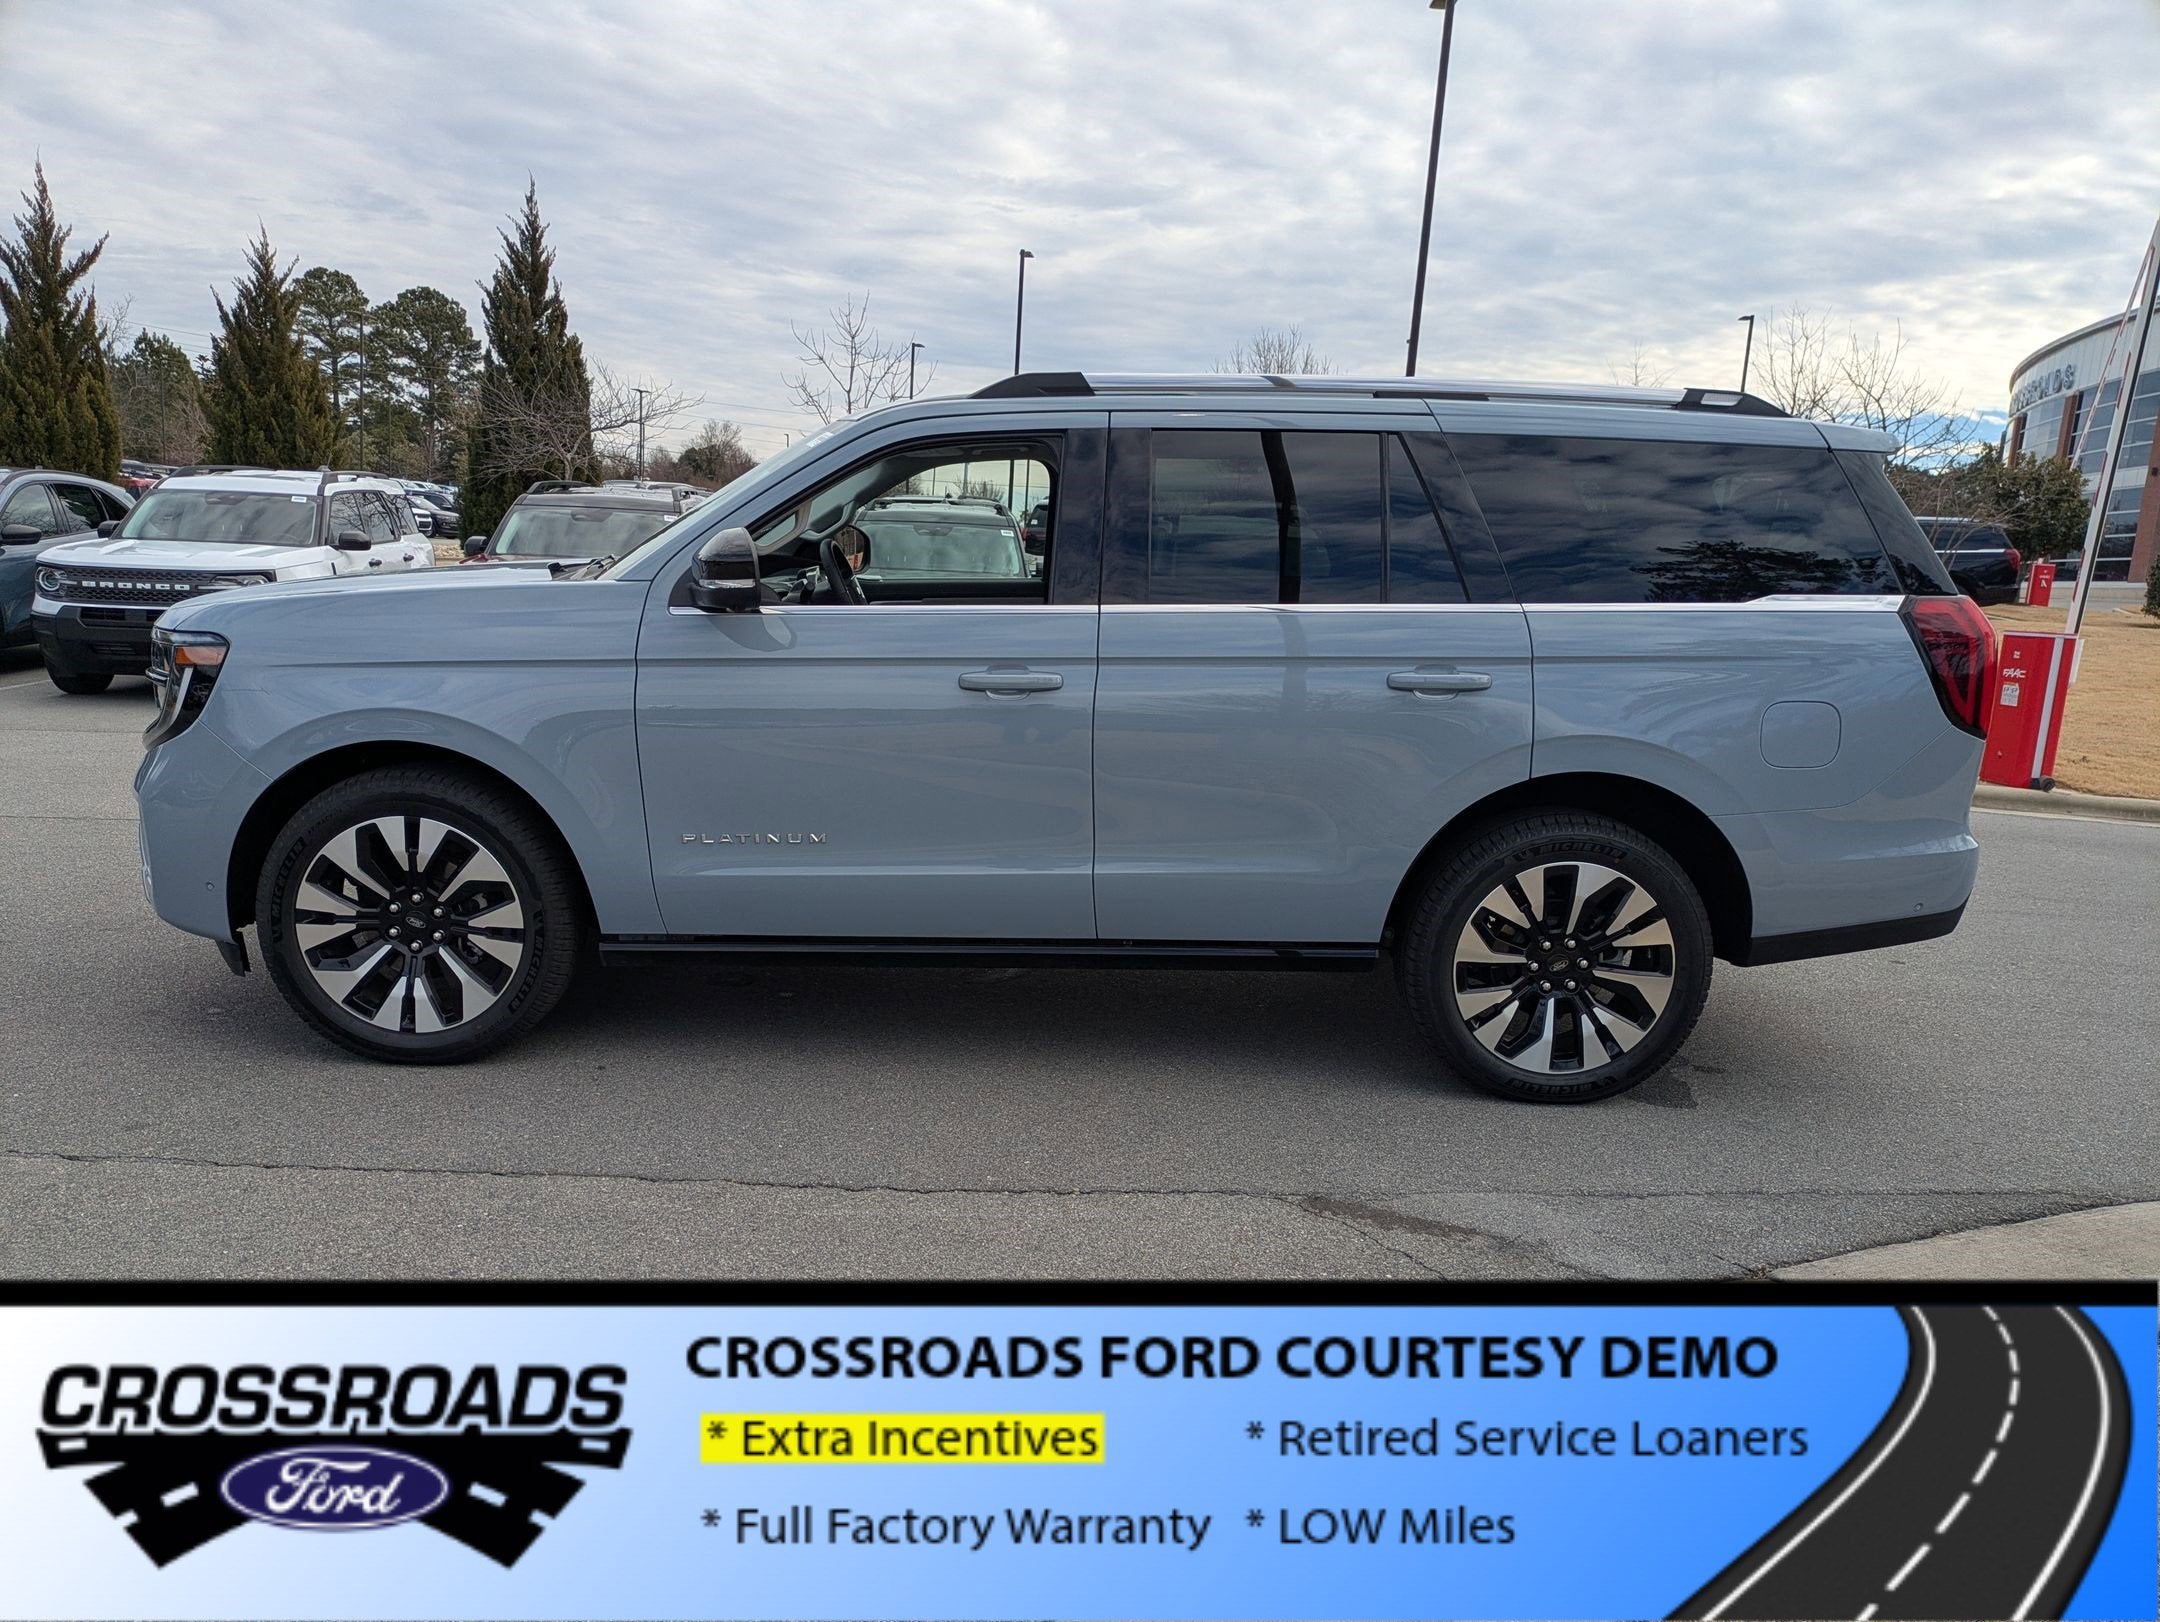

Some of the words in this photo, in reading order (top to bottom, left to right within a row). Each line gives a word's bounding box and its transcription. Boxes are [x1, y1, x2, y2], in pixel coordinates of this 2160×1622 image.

[82, 581, 190, 590] BRONCO
[682, 833, 826, 844] PLATINUM
[271, 838, 304, 916] MICHELIN
[508, 935, 545, 1012] MICHELIN
